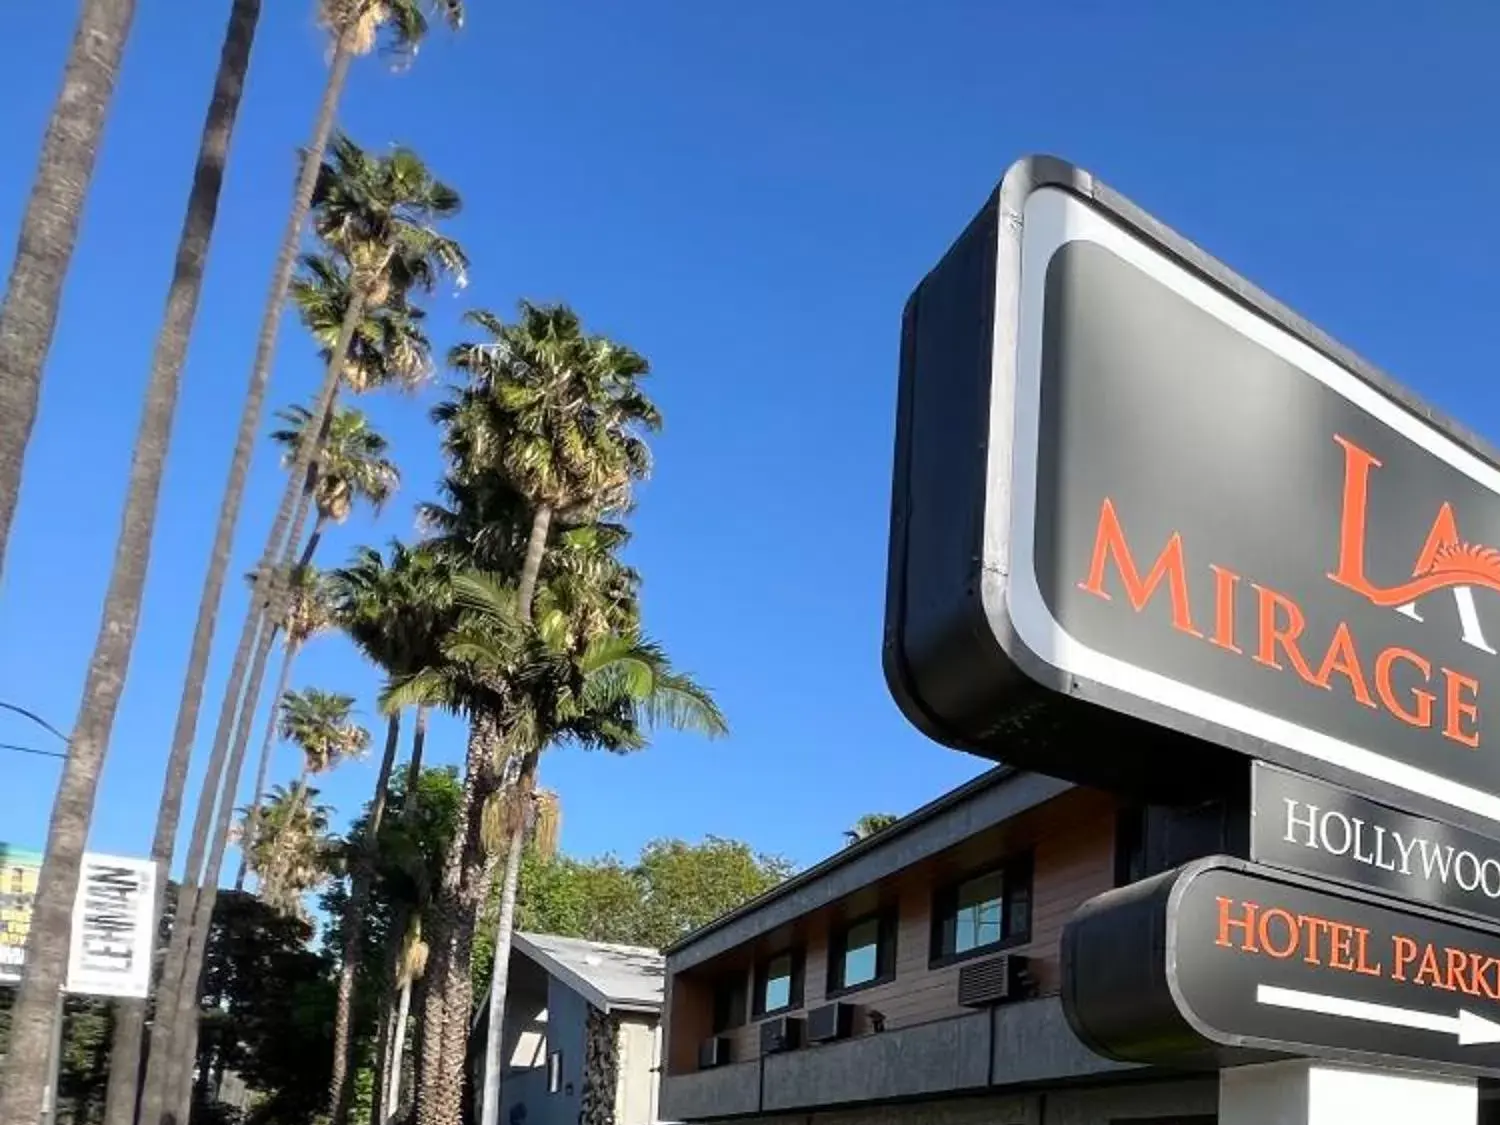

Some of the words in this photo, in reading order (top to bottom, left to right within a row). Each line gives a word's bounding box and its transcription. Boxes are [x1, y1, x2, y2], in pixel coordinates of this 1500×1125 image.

[1077, 497, 1480, 749] MIRAGE
[81, 864, 138, 973] LEHMAN
[1213, 895, 1383, 977] HOTEL
